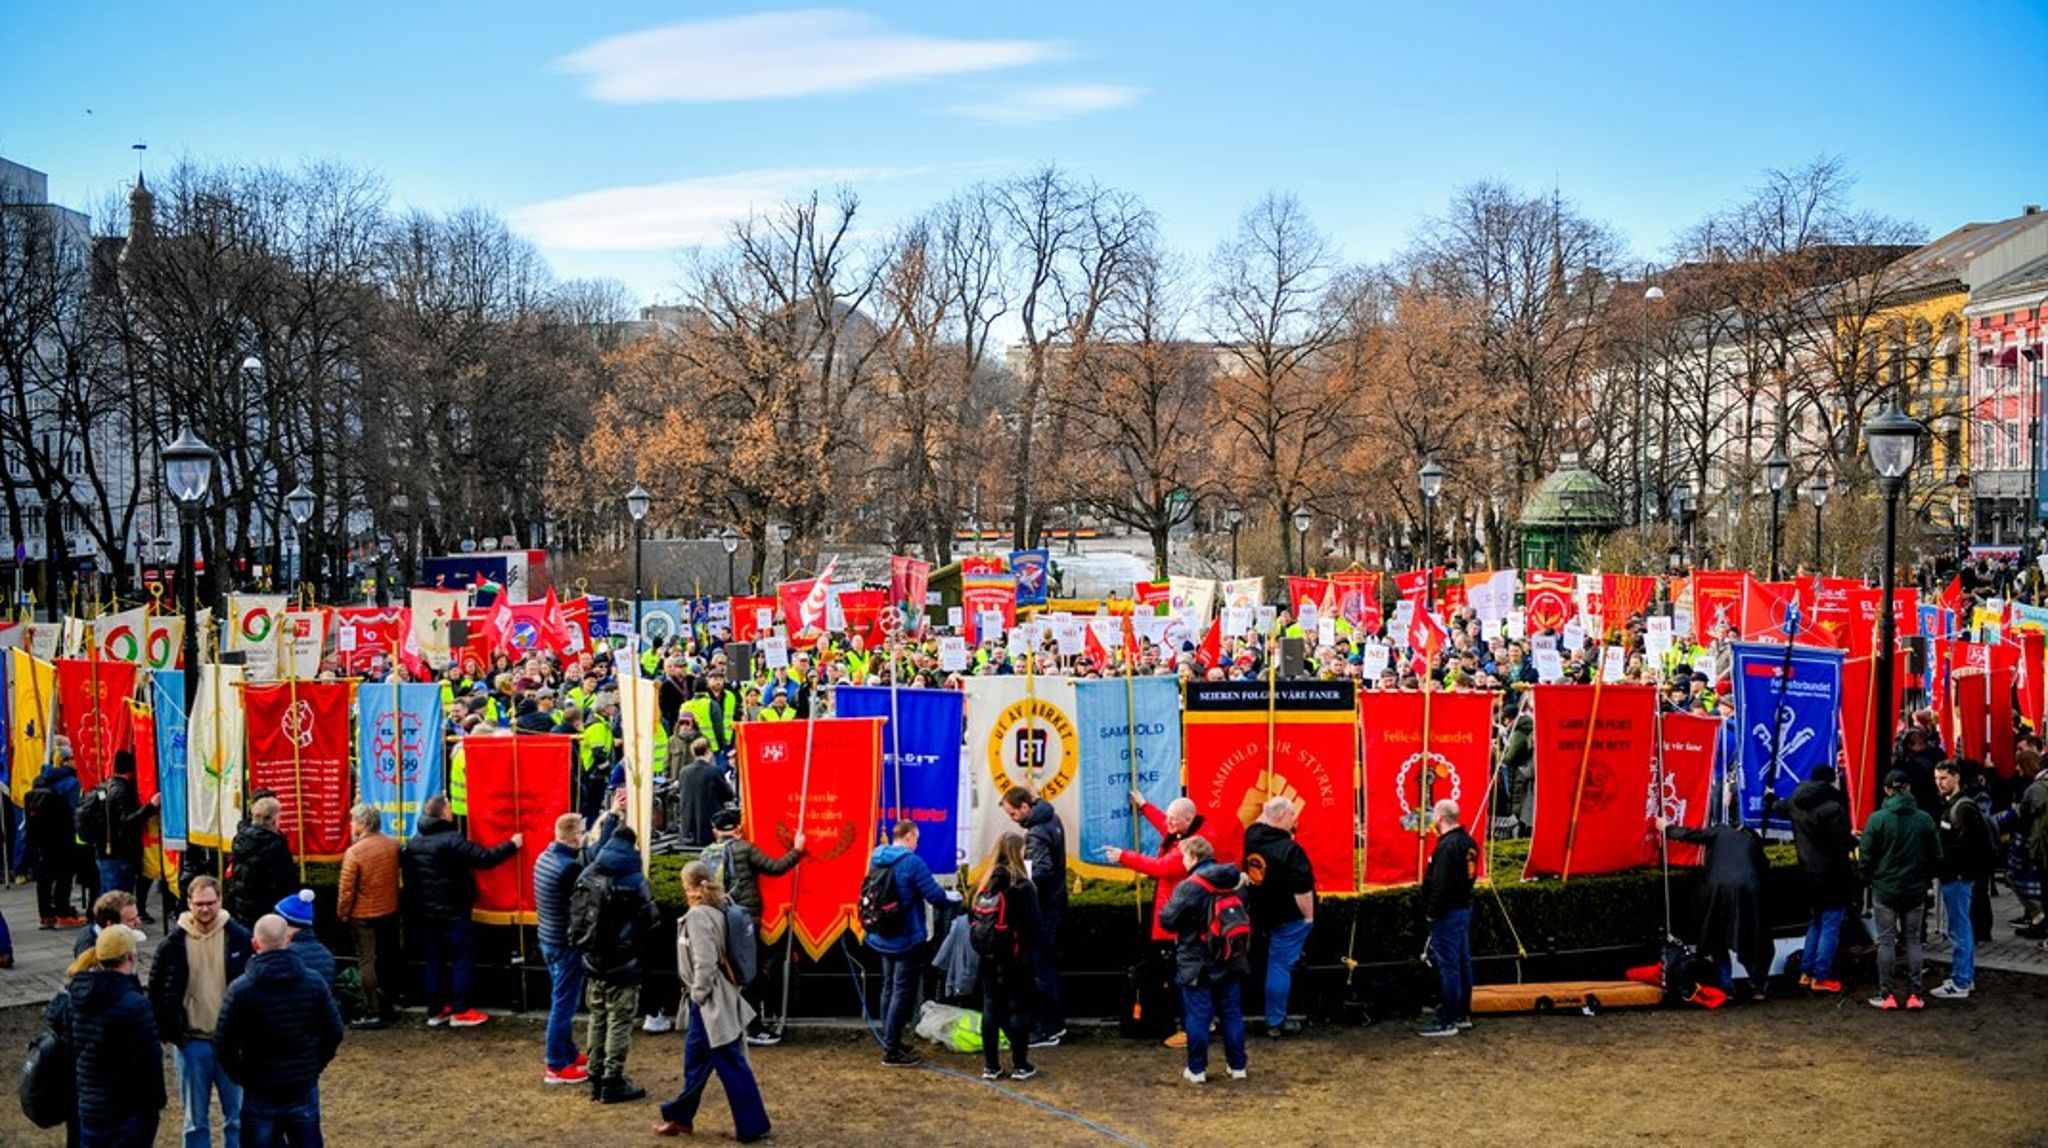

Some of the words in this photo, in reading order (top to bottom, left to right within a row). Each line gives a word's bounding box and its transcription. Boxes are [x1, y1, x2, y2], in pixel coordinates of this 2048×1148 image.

[1120, 747, 1144, 760] GR
[1209, 742, 1260, 809] SAMHOLD
[1297, 747, 1336, 807] STYRKE
